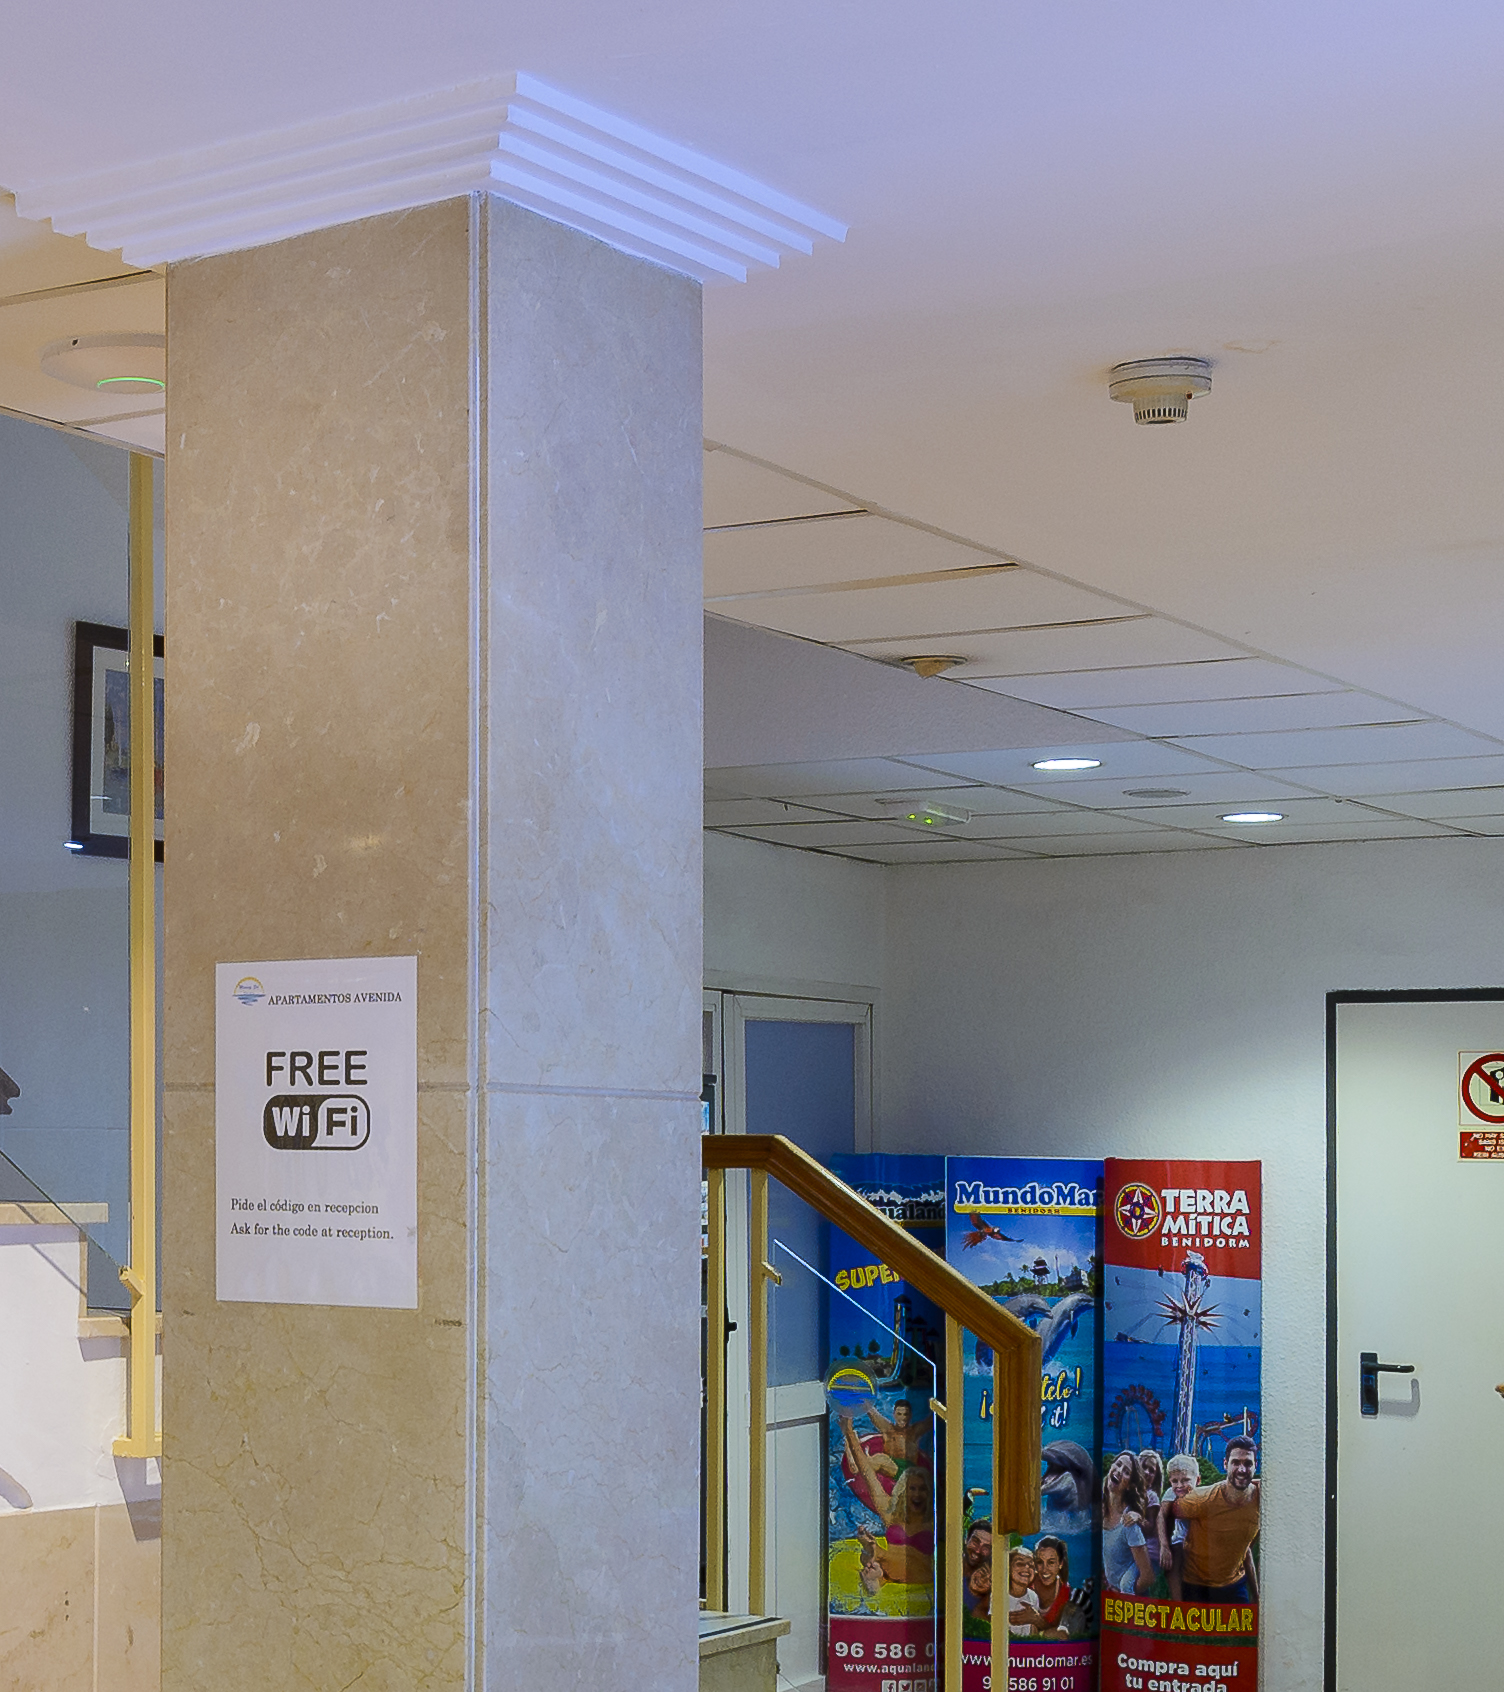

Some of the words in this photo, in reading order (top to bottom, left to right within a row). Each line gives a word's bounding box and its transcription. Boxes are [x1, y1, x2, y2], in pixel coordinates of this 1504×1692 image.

[268, 993, 352, 1005] APARTAMENTOS
[354, 992, 402, 1003] AVENIDA
[266, 1050, 368, 1087] FREE
[272, 1105, 358, 1137] WiFi
[955, 1180, 1100, 1207] MundoMar
[1161, 1189, 1250, 1213] TERRA
[231, 1198, 254, 1211] Pide
[257, 1199, 267, 1212] el
[270, 1200, 304, 1214] código
[308, 1203, 320, 1213] en
[325, 1201, 379, 1216] recepcion
[230, 1222, 251, 1235] Ask
[254, 1224, 269, 1235] for
[273, 1224, 290, 1236] the
[293, 1224, 318, 1237] code
[322, 1227, 332, 1238] at
[336, 1227, 394, 1241] reception.
[1161, 1237, 1249, 1248] BENIDORM
[1105, 1598, 1253, 1631] ESPECTACULAR
[835, 1642, 864, 1658] 96
[874, 1643, 916, 1659] 586
[1117, 1654, 1189, 1676] Compra
[1195, 1661, 1239, 1679] aquí
[1008, 1677, 1037, 1691] 586
[1042, 1678, 1057, 1690] 91
[1060, 1676, 1075, 1690] 01
[1126, 1674, 1142, 1689] tu
